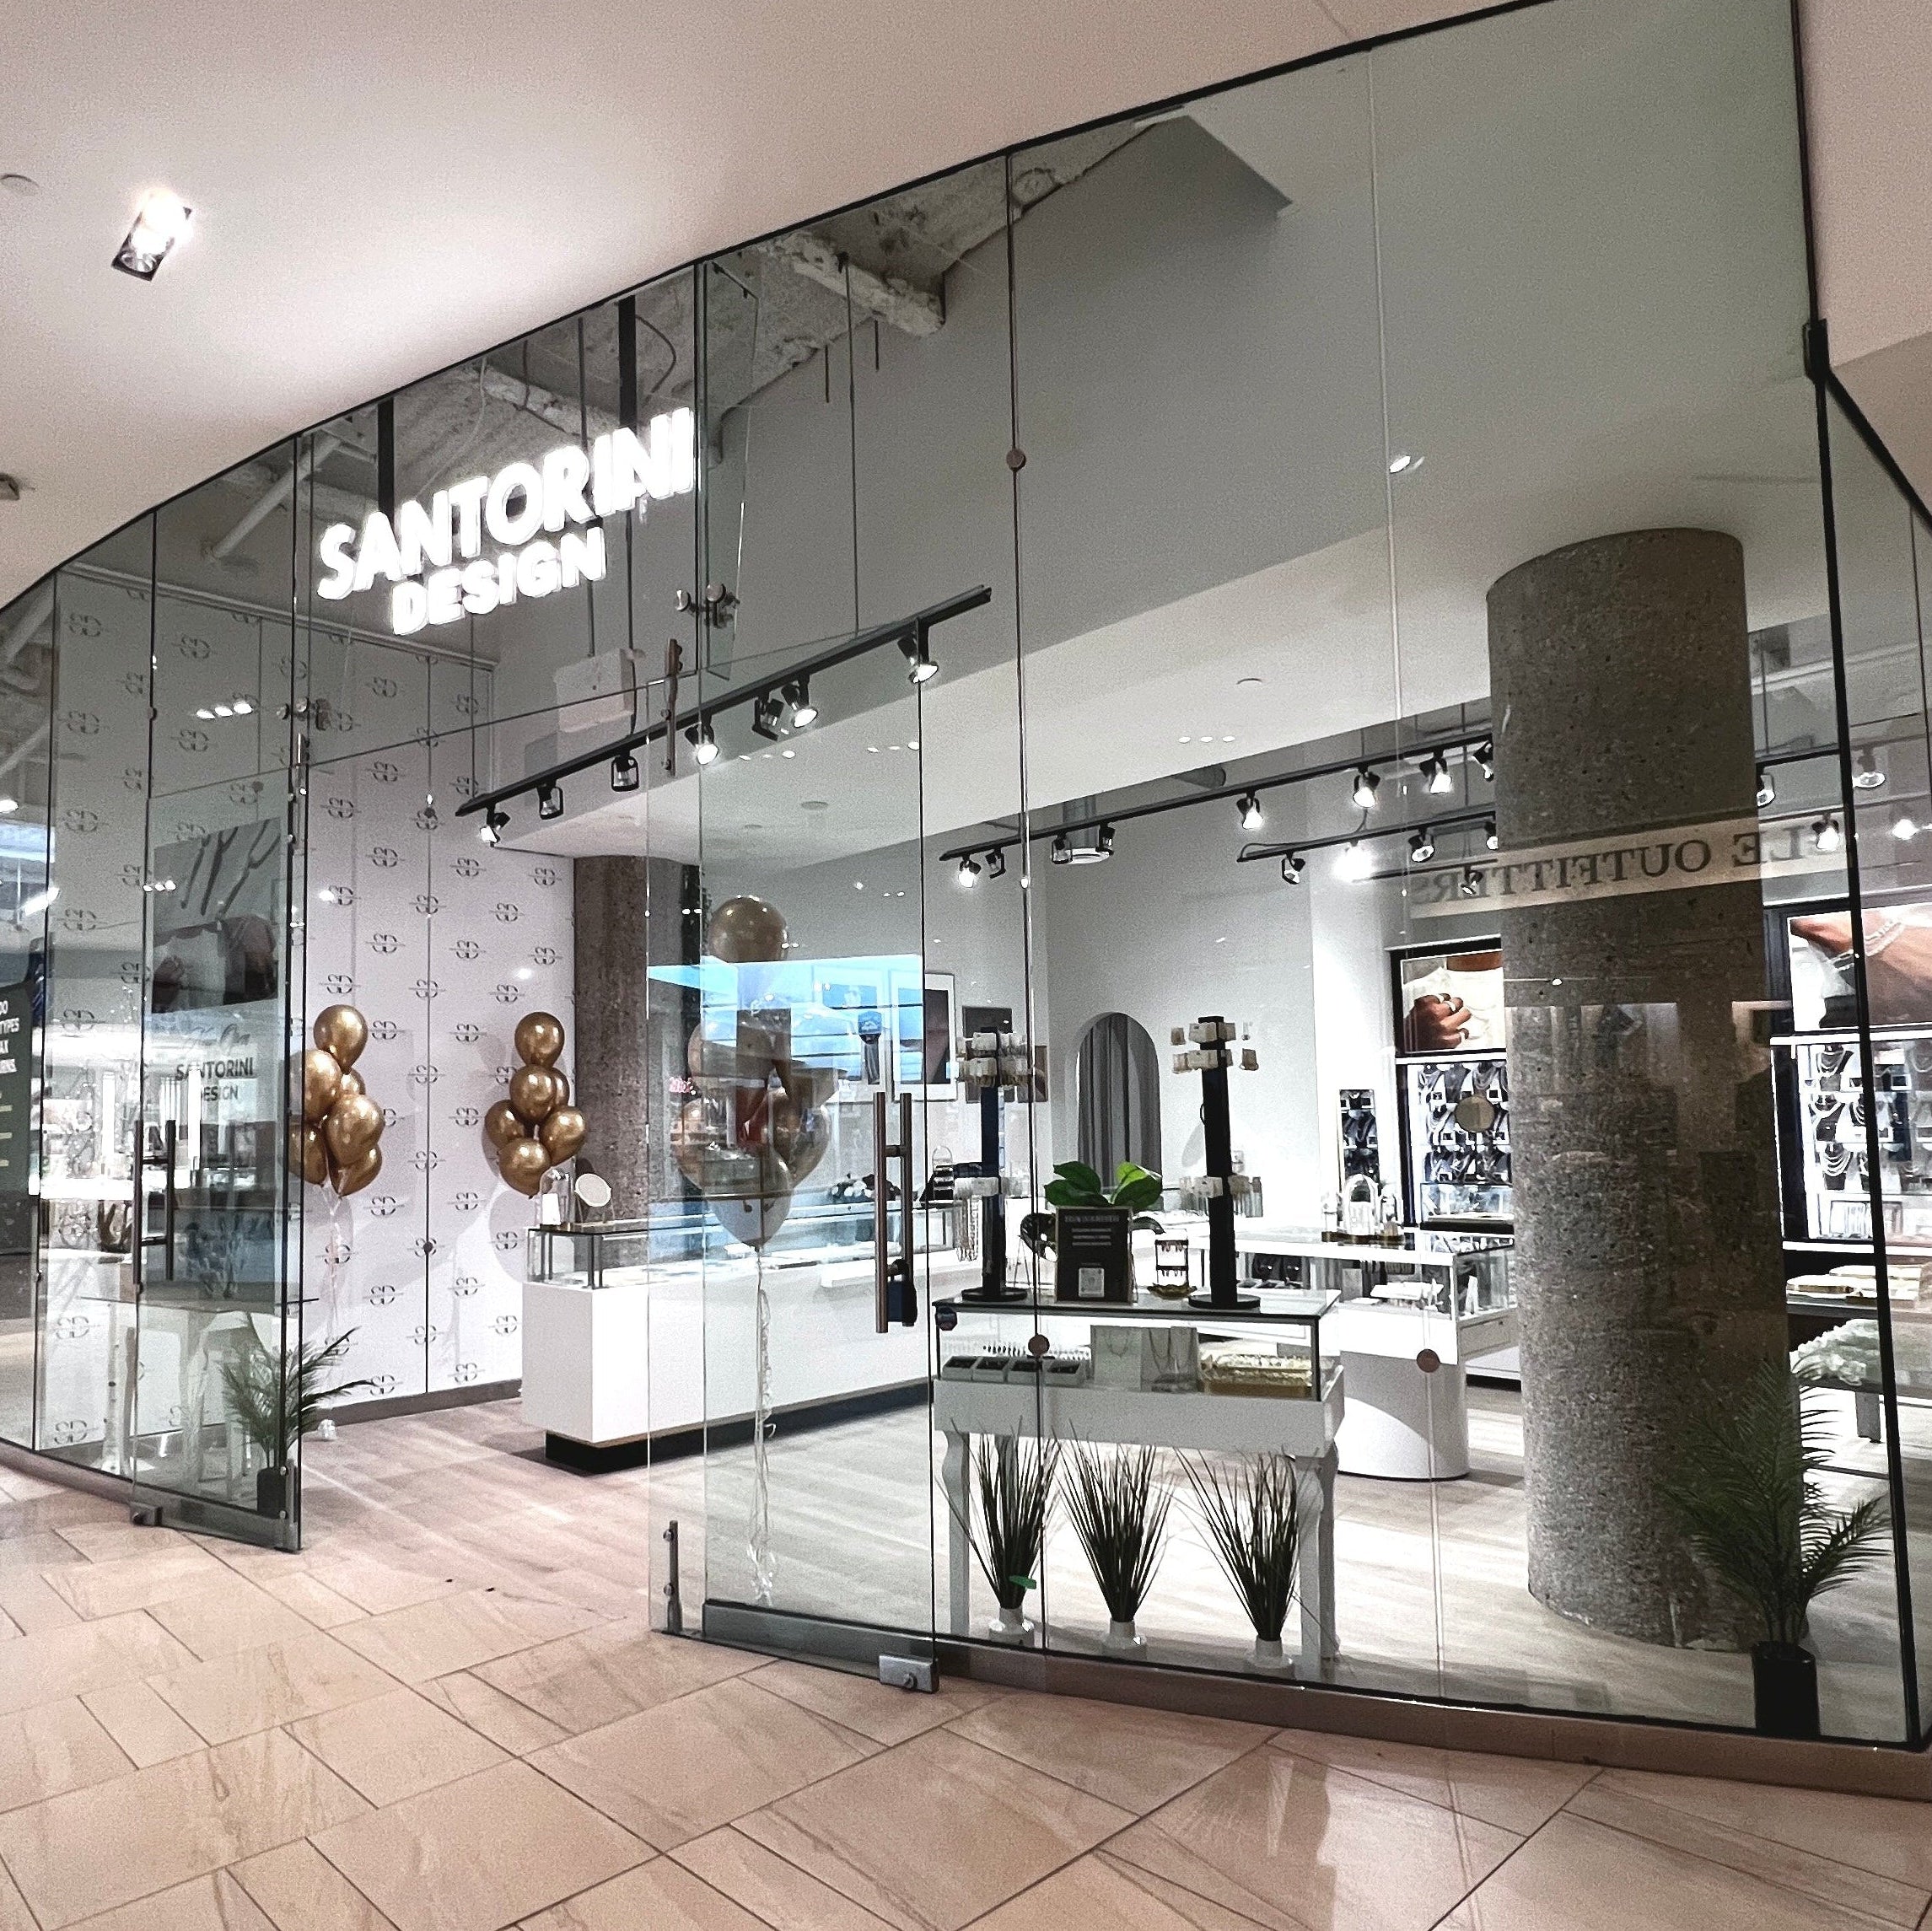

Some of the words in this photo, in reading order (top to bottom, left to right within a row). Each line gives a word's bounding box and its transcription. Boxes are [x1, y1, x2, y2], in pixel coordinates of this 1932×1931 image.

[317, 406, 695, 600] SANTORINI
[392, 526, 606, 635] DESIGN
[175, 1057, 254, 1081] STORINI
[200, 1084, 239, 1102] ESGN
